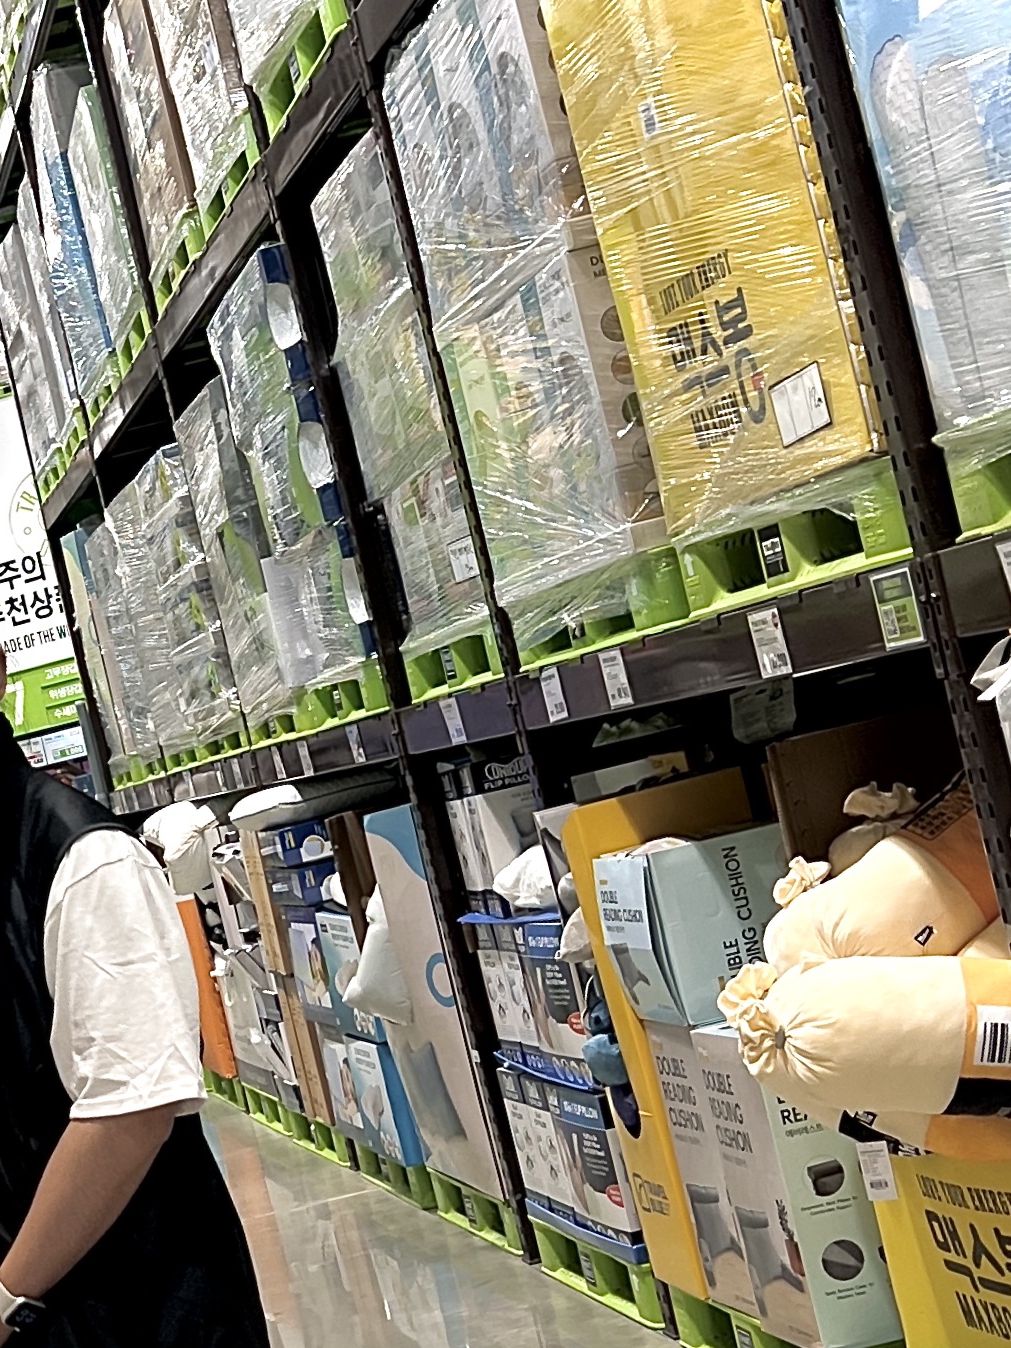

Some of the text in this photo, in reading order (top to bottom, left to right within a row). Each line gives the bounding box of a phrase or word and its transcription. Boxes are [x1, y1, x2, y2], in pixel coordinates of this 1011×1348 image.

[16, 490, 39, 512] TR
[3, 636, 21, 654] ADE
[23, 633, 35, 649] OF
[37, 628, 56, 645] THE
[505, 774, 530, 785] PILLO
[721, 846, 752, 921] CUSHION
[656, 1055, 688, 1079] DOUBLE
[662, 1081, 697, 1107] READING
[701, 1069, 734, 1096] DOUBLE
[668, 1106, 705, 1133] CUSHION
[709, 1096, 744, 1125] READING
[715, 1124, 754, 1154] CUSHION
[966, 1186, 1011, 1216] ENERG
